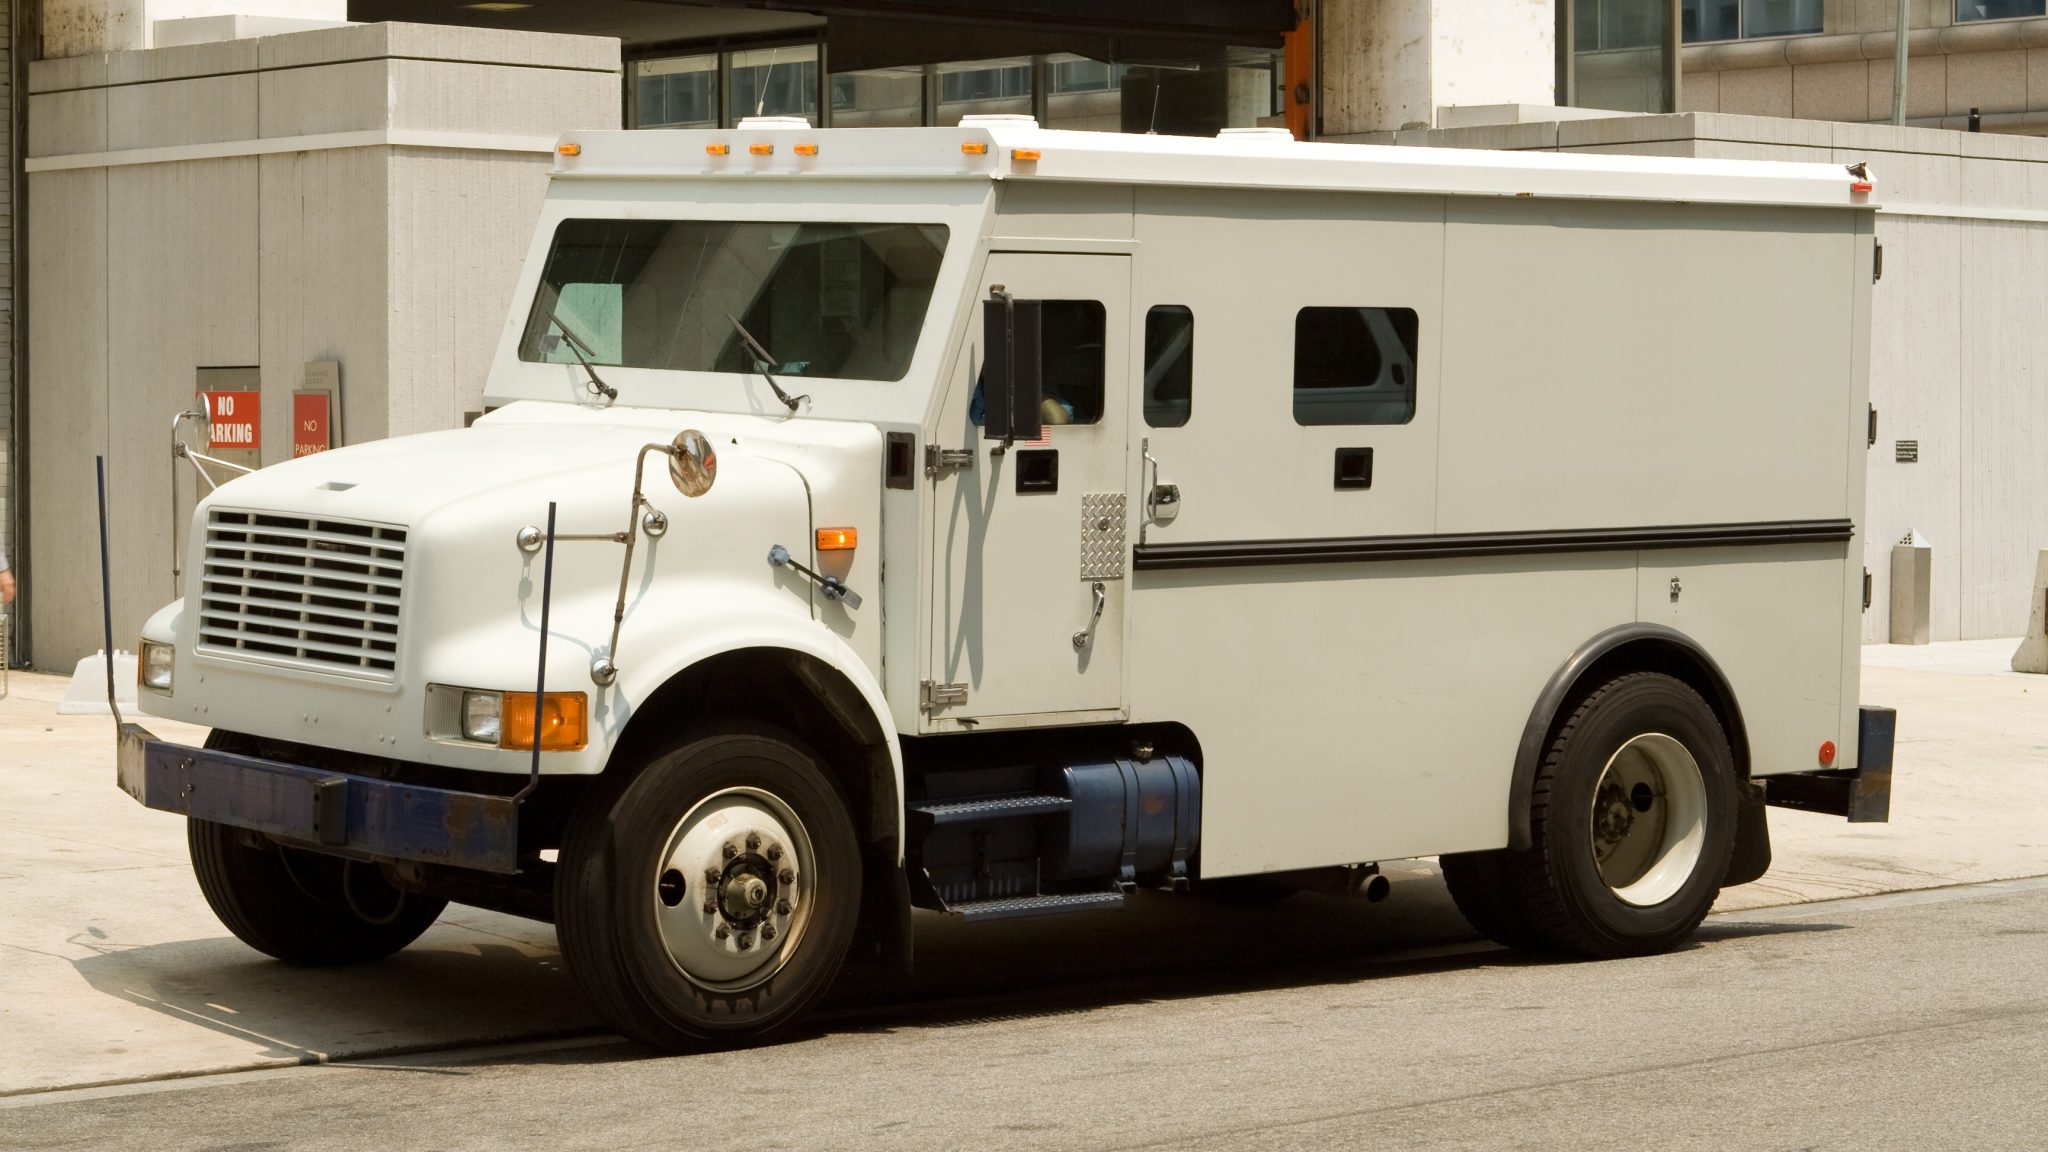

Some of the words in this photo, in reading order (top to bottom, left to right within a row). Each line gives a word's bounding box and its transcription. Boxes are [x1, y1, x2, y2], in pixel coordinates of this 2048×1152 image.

[217, 396, 234, 416] NO
[210, 423, 253, 443] ARKING
[304, 420, 318, 432] NO
